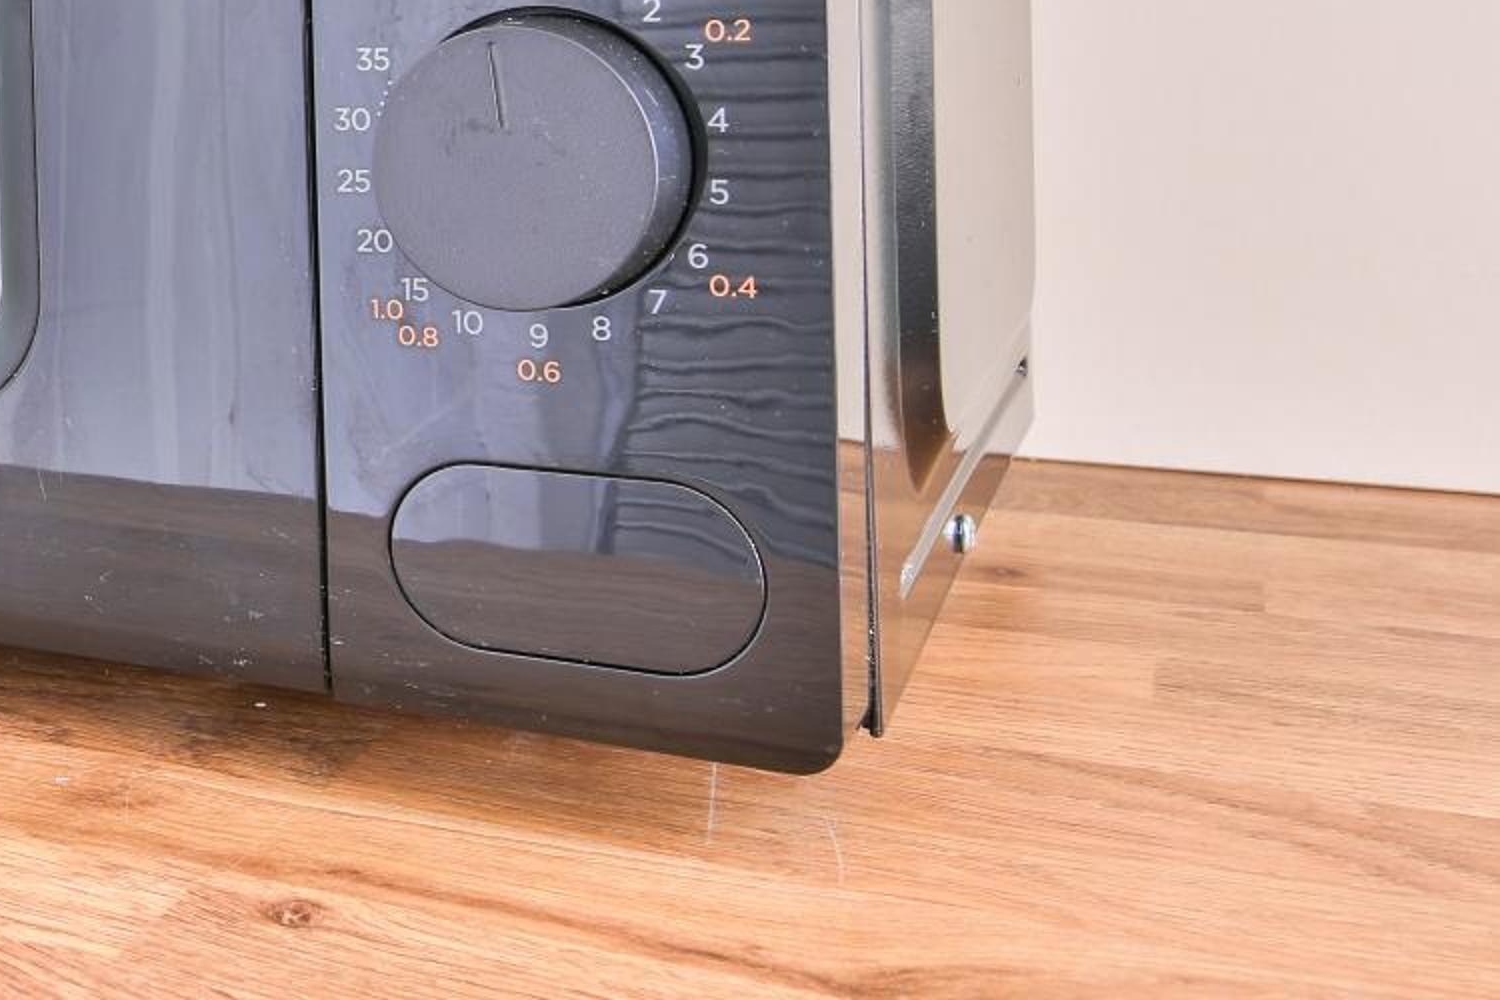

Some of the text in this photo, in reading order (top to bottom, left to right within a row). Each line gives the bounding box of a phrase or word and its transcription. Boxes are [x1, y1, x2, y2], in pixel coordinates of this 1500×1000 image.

[705, 19, 751, 42] 0.2
[356, 47, 390, 72] 35
[684, 43, 704, 69] 3
[334, 107, 372, 132] 30
[707, 107, 730, 133] 4
[337, 169, 371, 193] 25
[709, 179, 729, 205] 5
[356, 229, 393, 253] 20
[687, 244, 709, 269] 6
[401, 277, 429, 301] 15
[708, 274, 758, 299] 0.4
[371, 299, 403, 320] 1.0
[648, 289, 668, 315] 7
[451, 311, 483, 335] 10
[592, 316, 612, 341] 8
[398, 325, 439, 347] 0.8
[529, 324, 549, 348] 9
[516, 360, 561, 383] 0.6
